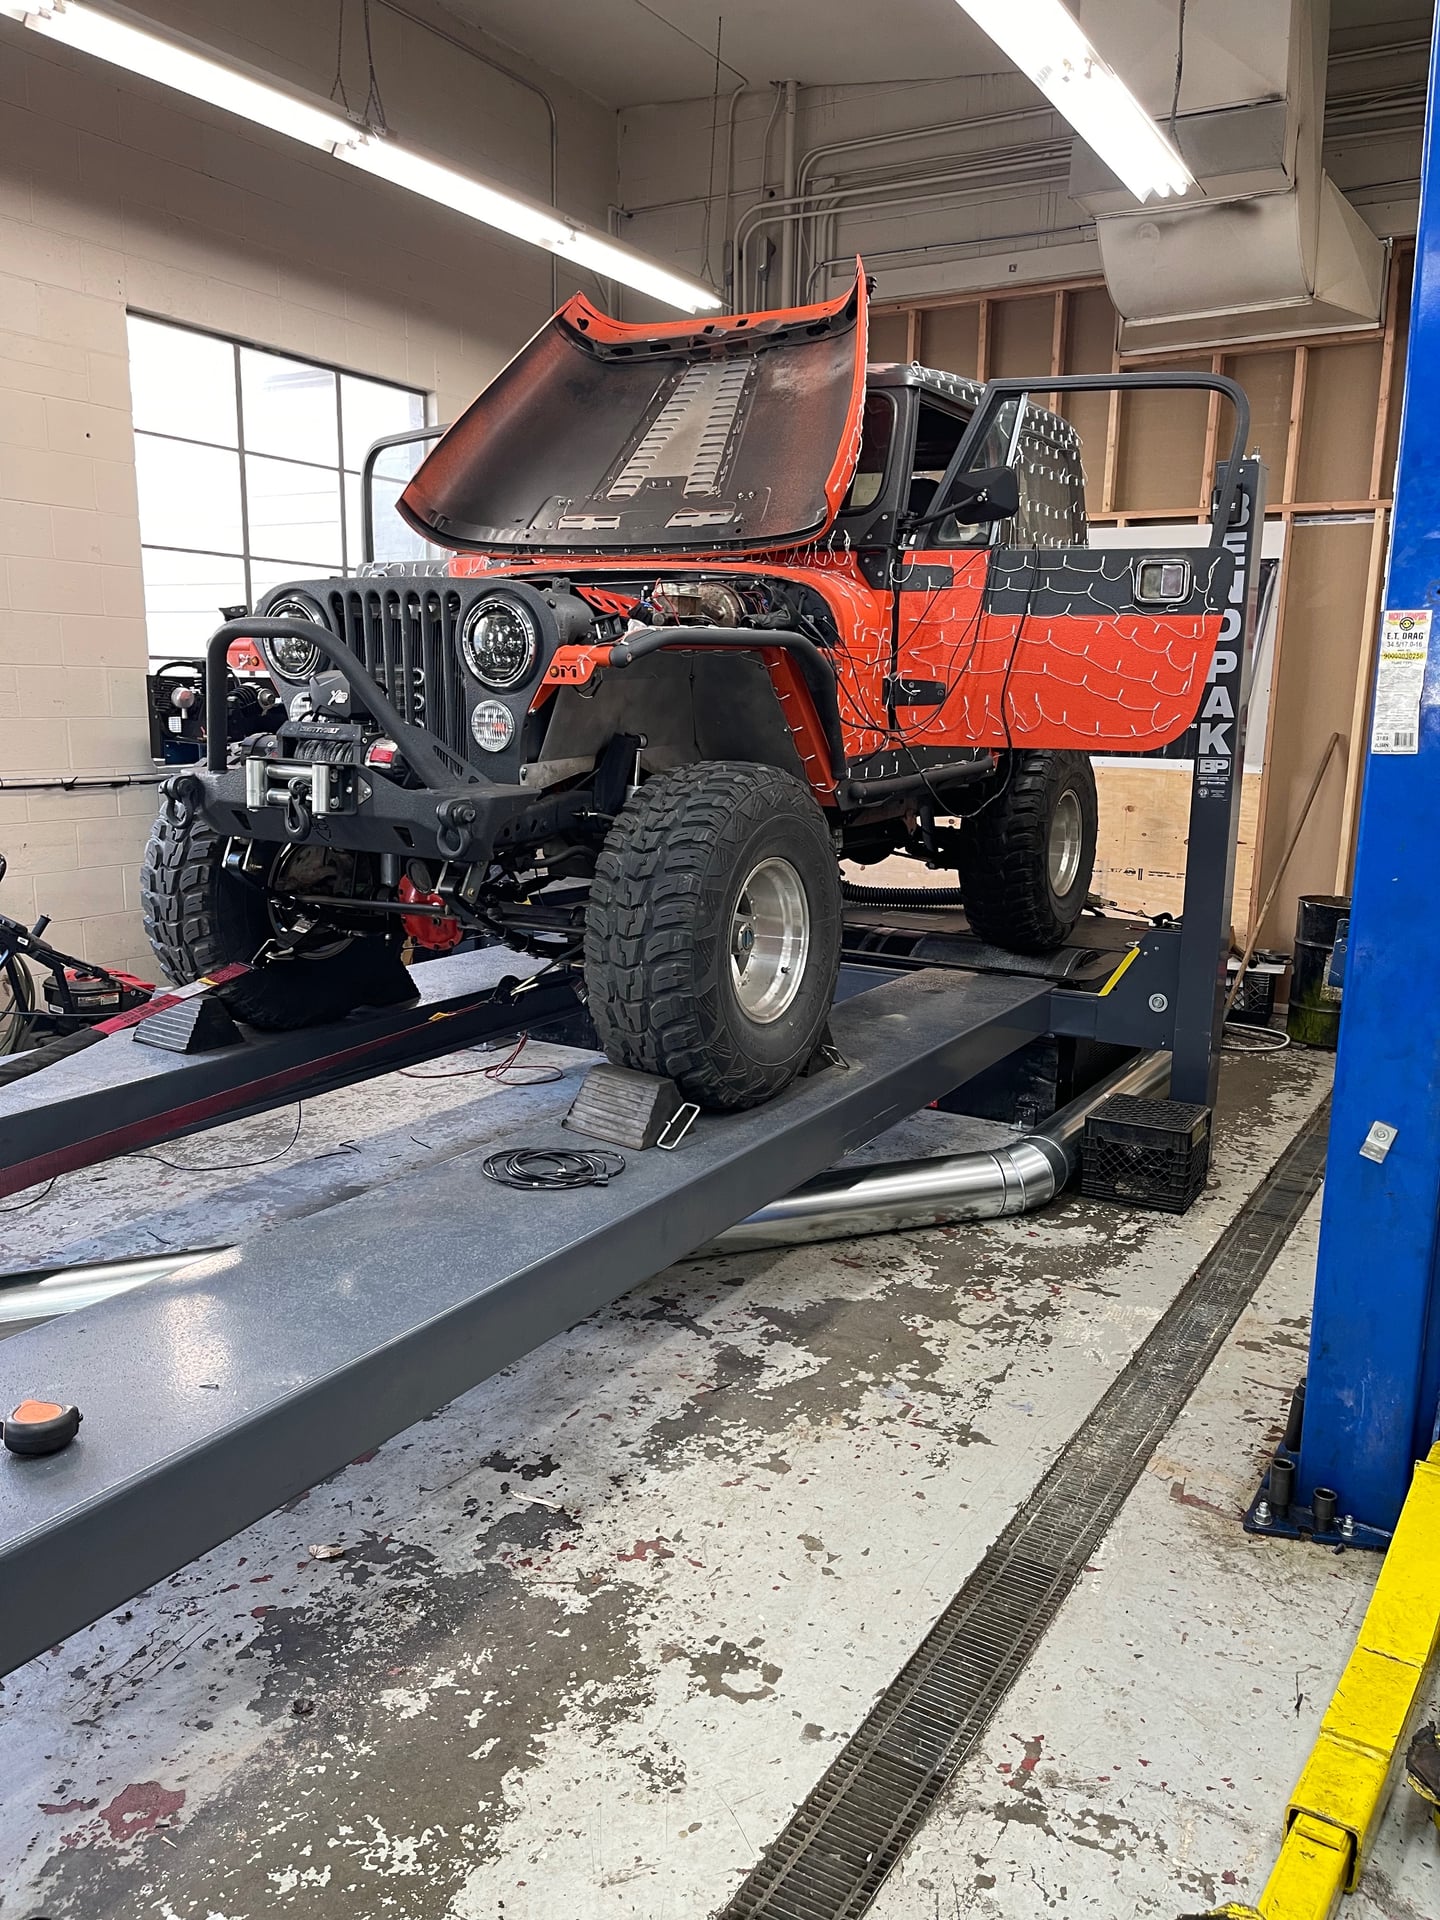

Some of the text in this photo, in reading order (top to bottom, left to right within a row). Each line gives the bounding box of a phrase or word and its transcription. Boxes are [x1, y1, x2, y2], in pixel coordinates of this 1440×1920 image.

[1387, 632, 1424, 640] E.T. DRAG
[1199, 759, 1229, 774] BP
